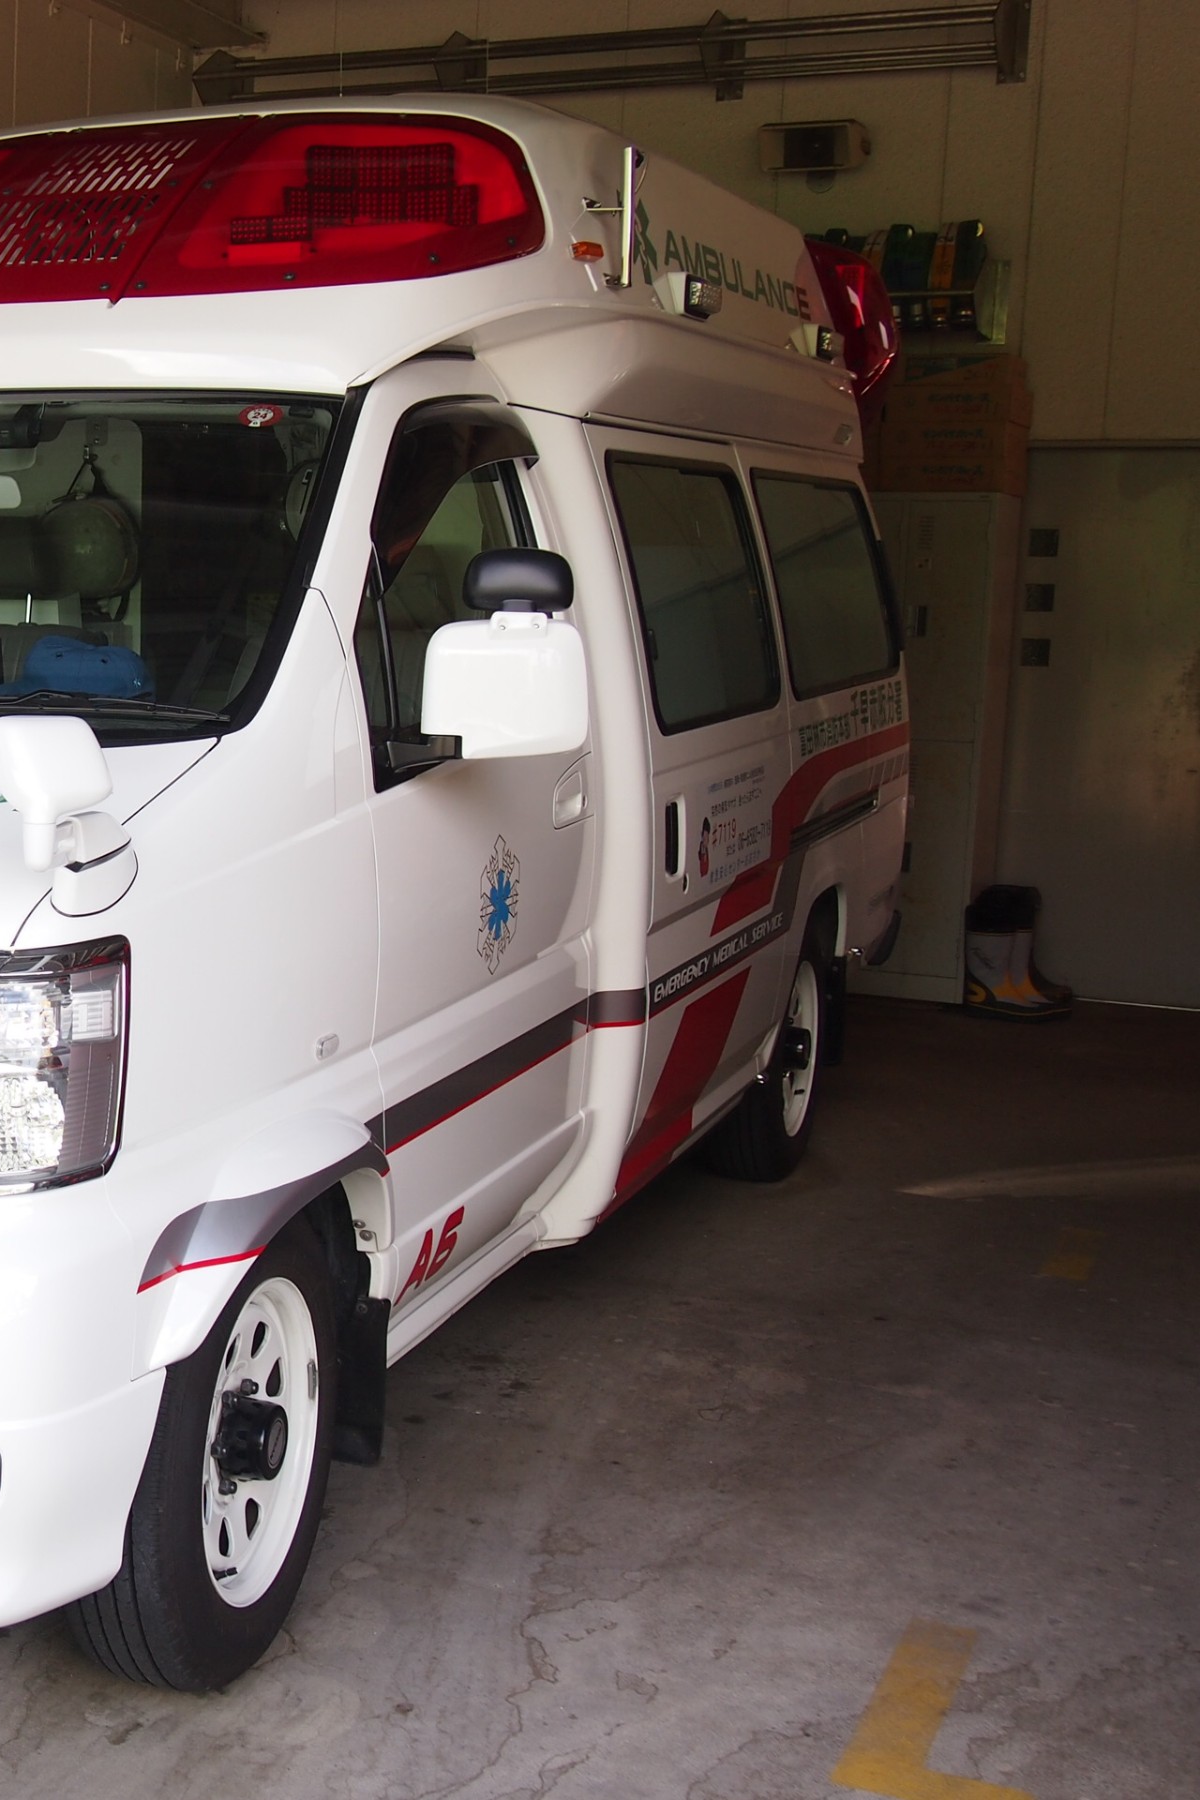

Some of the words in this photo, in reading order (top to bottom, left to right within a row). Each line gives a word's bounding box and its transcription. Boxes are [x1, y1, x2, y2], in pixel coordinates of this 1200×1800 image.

[664, 230, 812, 321] AMBULANCE
[654, 955, 711, 1003] EMERGENCY
[712, 933, 749, 967] MEDICAL
[751, 912, 784, 943] SERVICE
